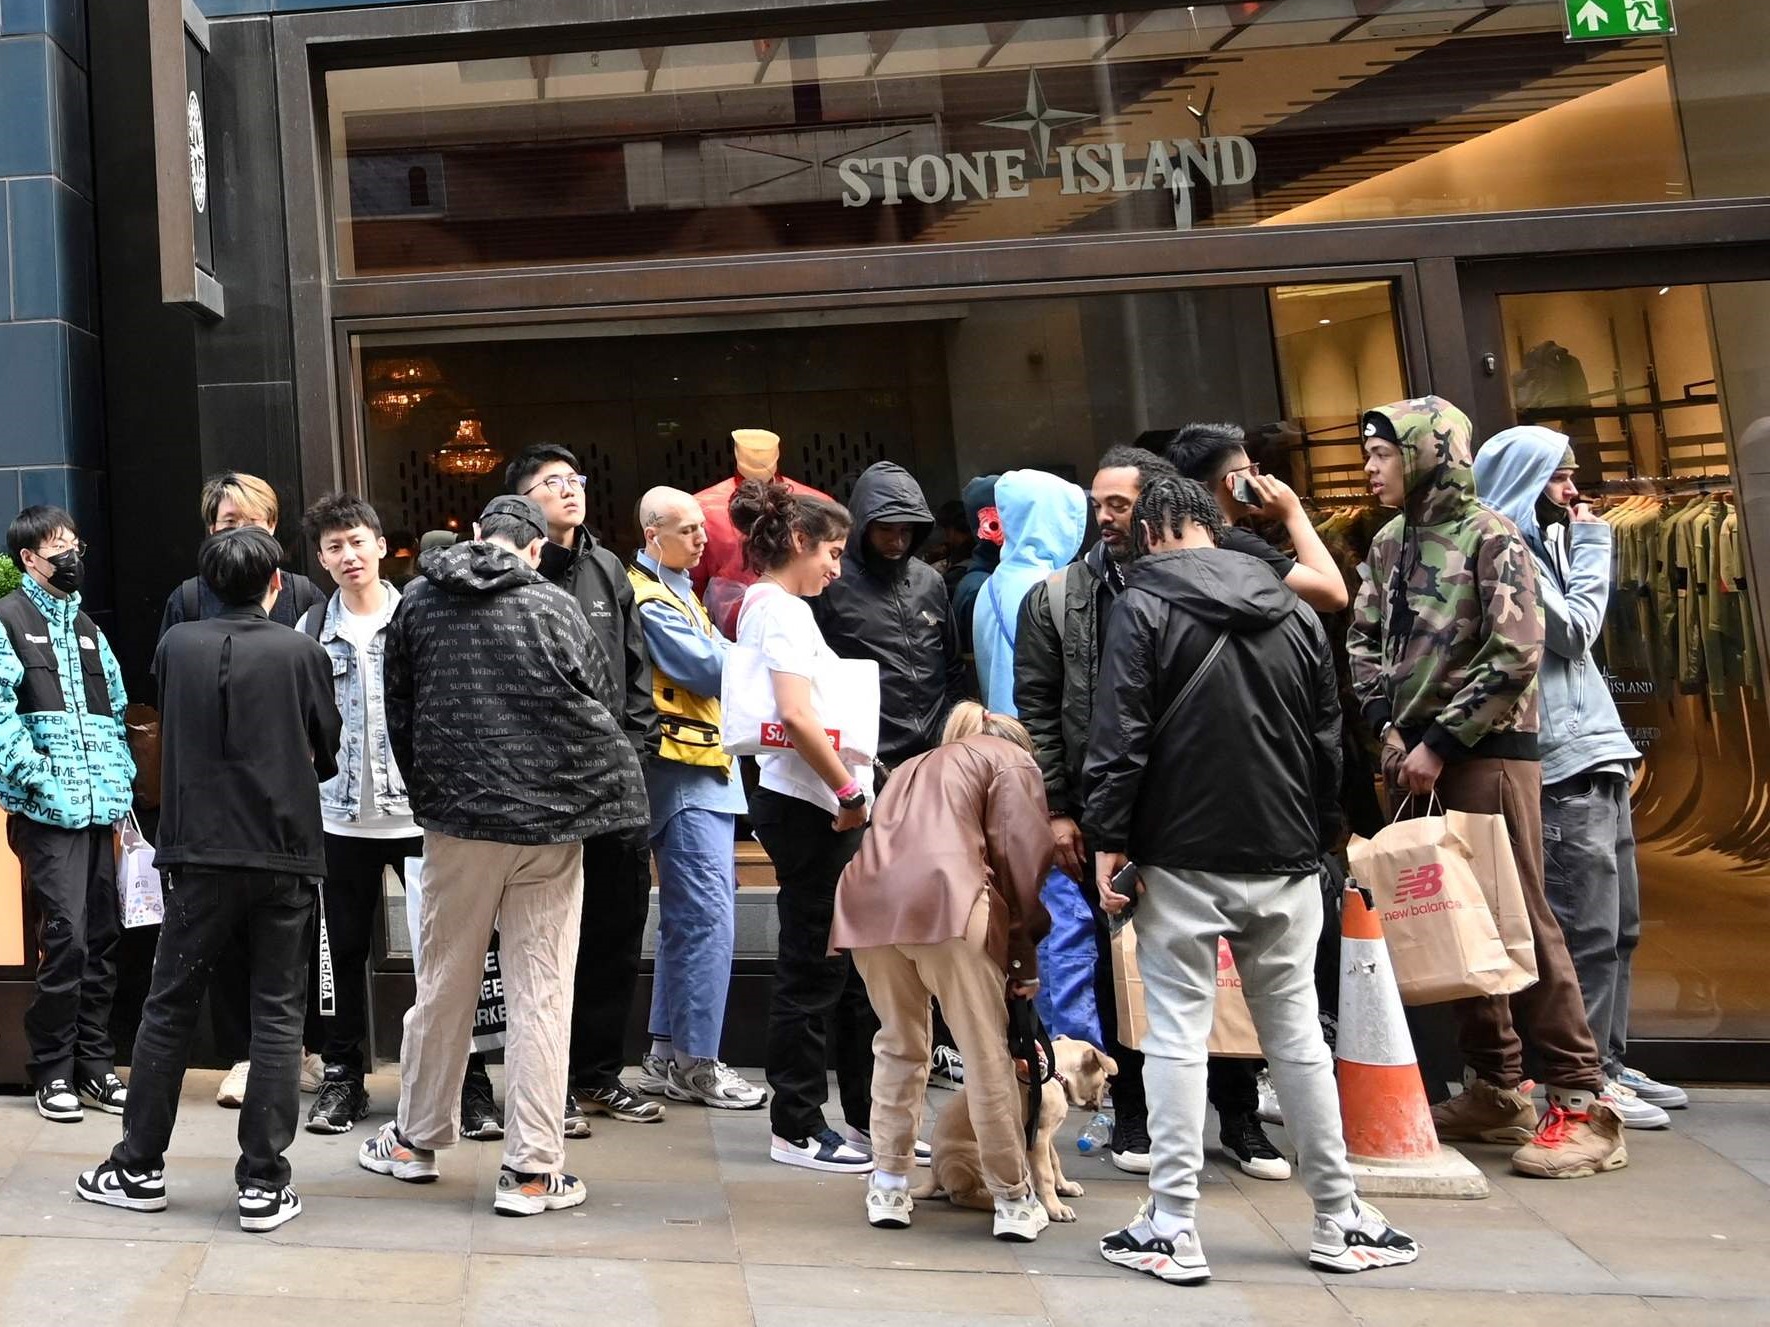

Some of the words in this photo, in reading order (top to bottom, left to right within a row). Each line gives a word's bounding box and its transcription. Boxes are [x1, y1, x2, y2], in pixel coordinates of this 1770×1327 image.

[837, 148, 1030, 209] STONE
[1055, 135, 1258, 196] ISLAND
[1384, 908, 1409, 921] new
[1410, 900, 1462, 916] balance
